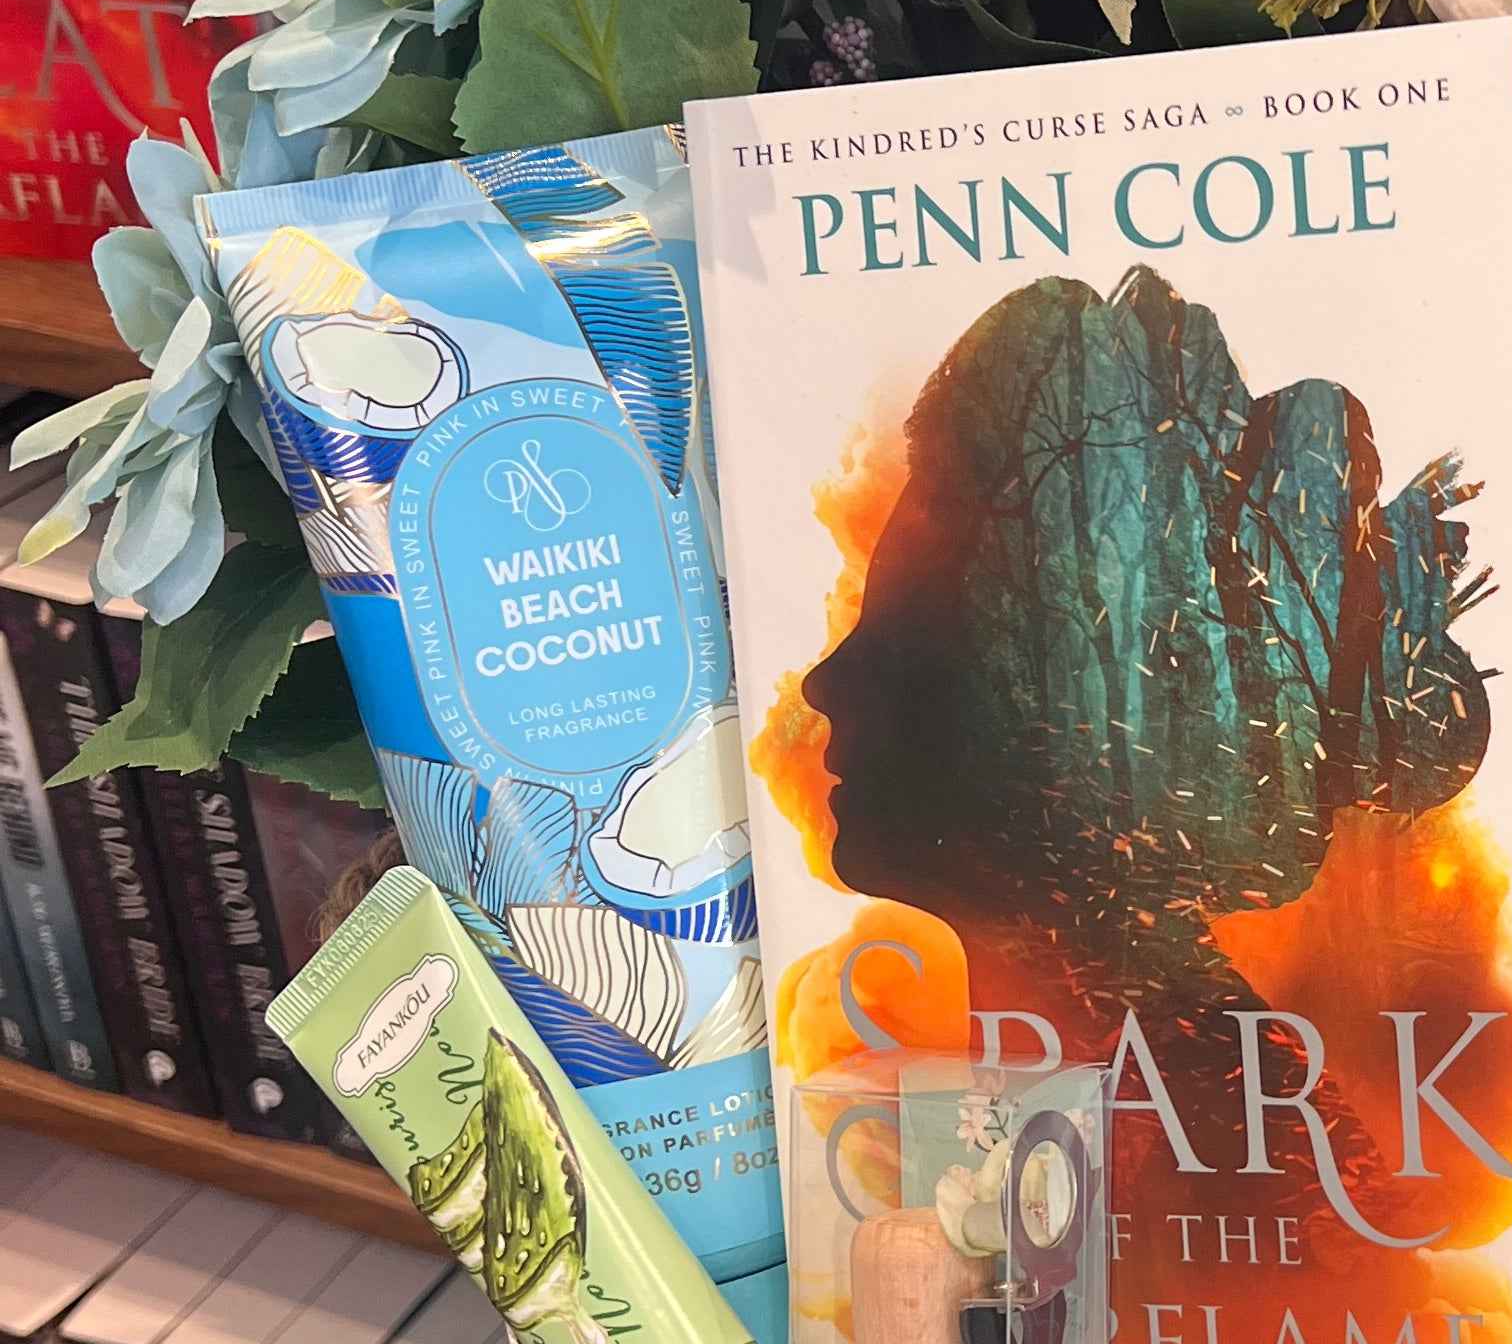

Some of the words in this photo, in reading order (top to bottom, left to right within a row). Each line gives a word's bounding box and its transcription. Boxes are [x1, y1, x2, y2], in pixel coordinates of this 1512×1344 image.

[22, 128, 110, 166] THE
[733, 139, 796, 170] THE
[810, 121, 988, 164] KINDRED'S
[1002, 110, 1107, 146] CURSE
[1123, 101, 1209, 134] SAGA
[1263, 86, 1362, 121] BOOK
[1377, 76, 1454, 107] ONE
[791, 170, 1074, 278] PENN
[1113, 141, 1399, 252] COLE
[472, 396, 501, 420] IN
[511, 387, 606, 414] SWEET
[416, 417, 467, 468] PINK
[400, 483, 426, 574] SWEET
[483, 532, 622, 588] WAIKIKI
[413, 585, 433, 611] IN
[500, 578, 624, 630] BEACH
[671, 509, 705, 595] SWEET
[692, 615, 718, 674] PINK
[420, 619, 447, 682] PINK
[475, 614, 663, 678] COCONUT
[508, 702, 565, 726] LONG
[571, 685, 657, 714] LASTING
[525, 706, 649, 744] FRAGRANCE
[355, 983, 432, 1070] FAYANKÔU
[639, 1167, 703, 1197] 36g
[1166, 1212, 1303, 1267] THE
